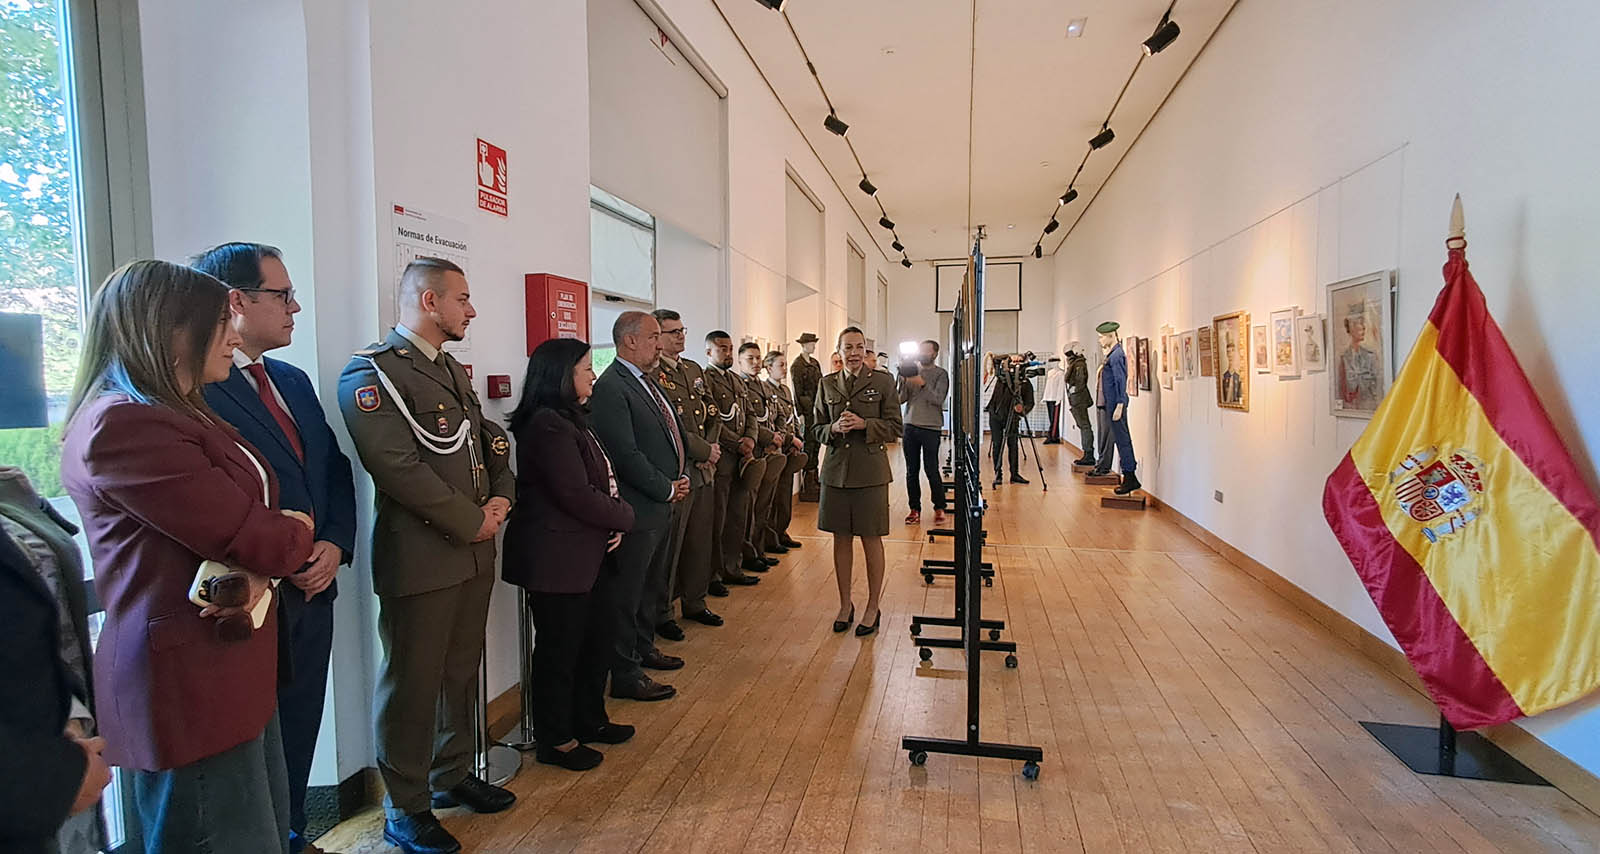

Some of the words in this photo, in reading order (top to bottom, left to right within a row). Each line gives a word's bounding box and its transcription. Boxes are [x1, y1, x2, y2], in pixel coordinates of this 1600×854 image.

[480, 199, 487, 207] DE
[398, 226, 424, 241] Normas
[426, 233, 434, 244] de
[435, 235, 467, 251] Evacuación
